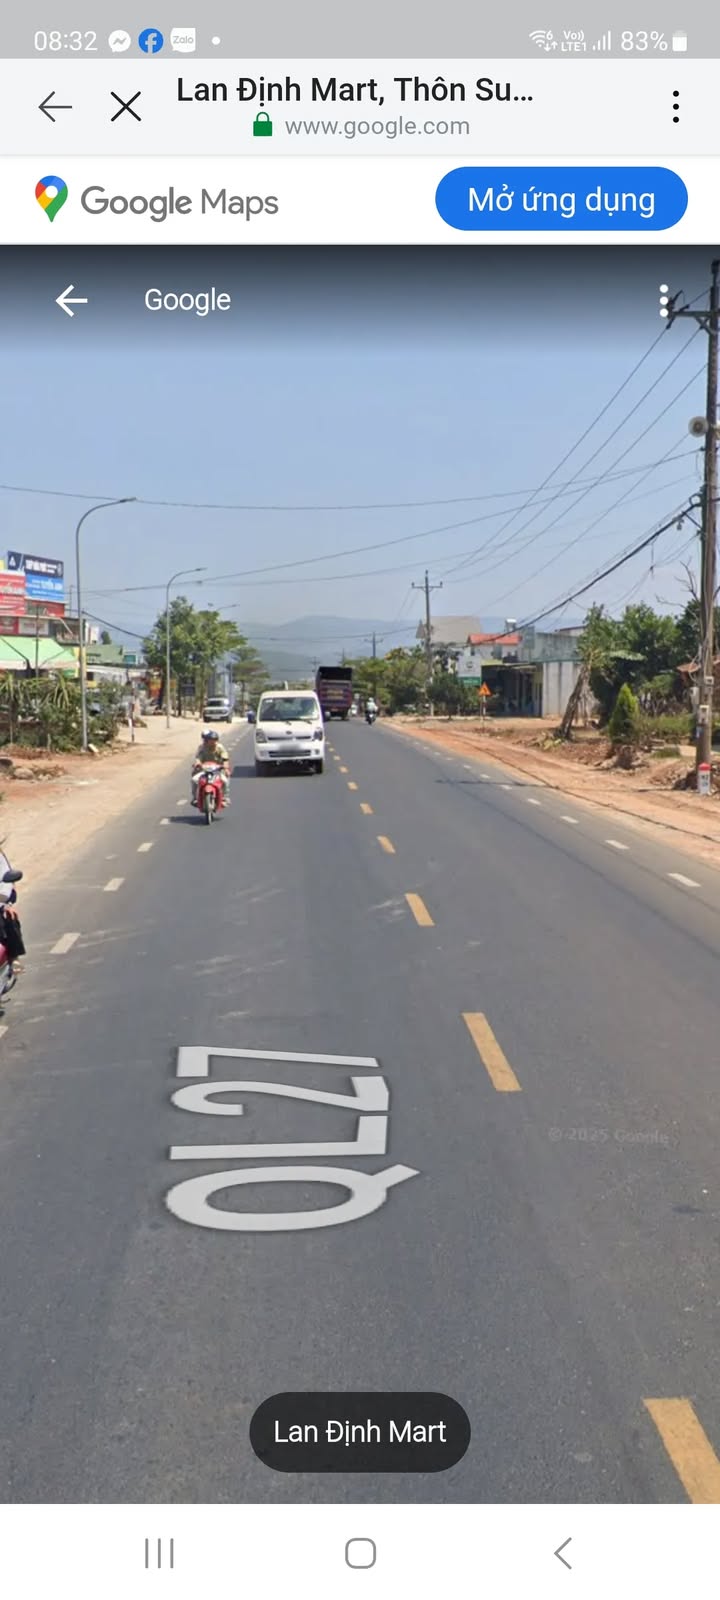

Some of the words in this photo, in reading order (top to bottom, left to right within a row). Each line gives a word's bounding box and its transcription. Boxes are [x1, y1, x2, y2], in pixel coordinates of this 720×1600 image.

[34, 30, 98, 51] 08:32
[172, 35, 194, 45] Zalo
[561, 42, 587, 52] LTE1
[620, 31, 668, 51] 83%
[177, 77, 228, 101] Lan
[236, 76, 301, 107] Định
[311, 77, 385, 106] Mart,
[394, 76, 466, 102] Thôn
[285, 116, 470, 139] www.google.com
[80, 185, 193, 223] Google
[201, 188, 279, 221] Maps
[468, 184, 514, 212] Mở
[523, 186, 576, 219] ứng
[585, 186, 655, 219] dụng
[144, 287, 231, 316] Google
[274, 1420, 318, 1443] Lan
[325, 1419, 381, 1447] Định
[389, 1420, 447, 1443] Mart
